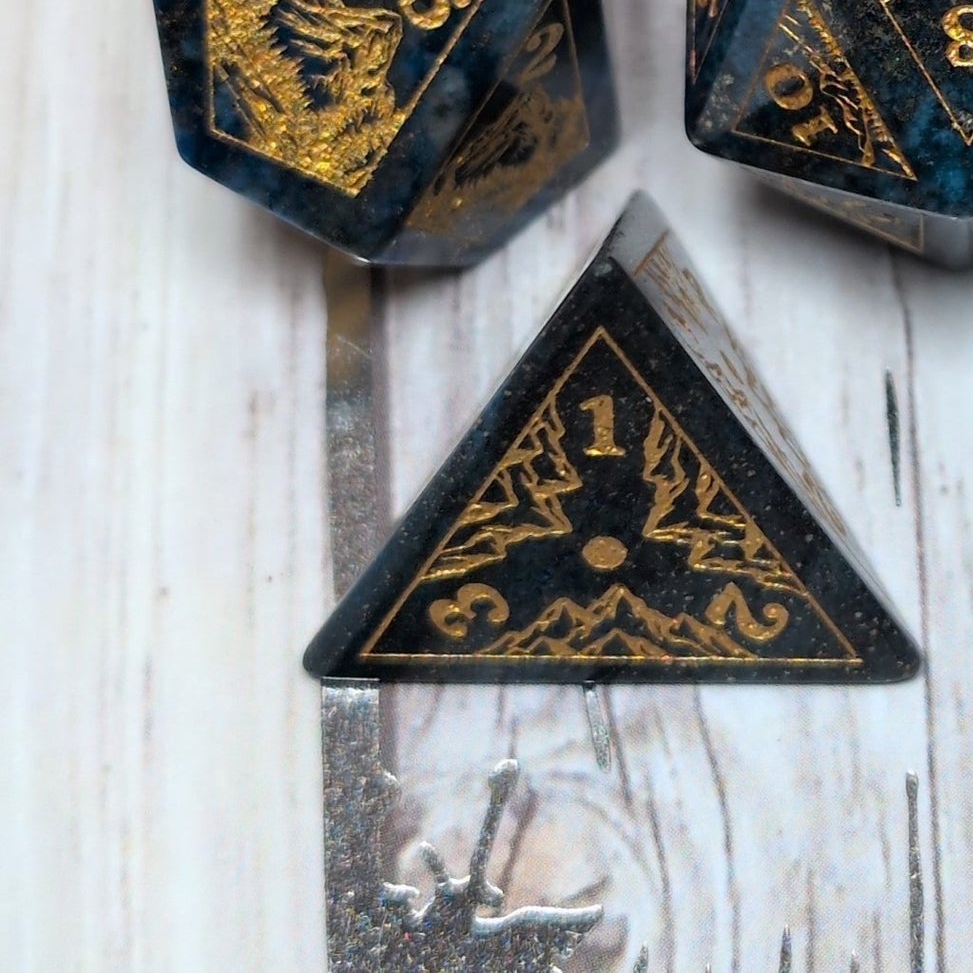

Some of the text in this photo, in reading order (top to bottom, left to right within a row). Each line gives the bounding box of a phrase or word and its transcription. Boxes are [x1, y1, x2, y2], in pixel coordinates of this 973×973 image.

[516, 22, 565, 86] 2
[761, 62, 839, 148] 10
[579, 393, 627, 457] 1
[428, 582, 511, 638] 3
[705, 581, 790, 641] 2
